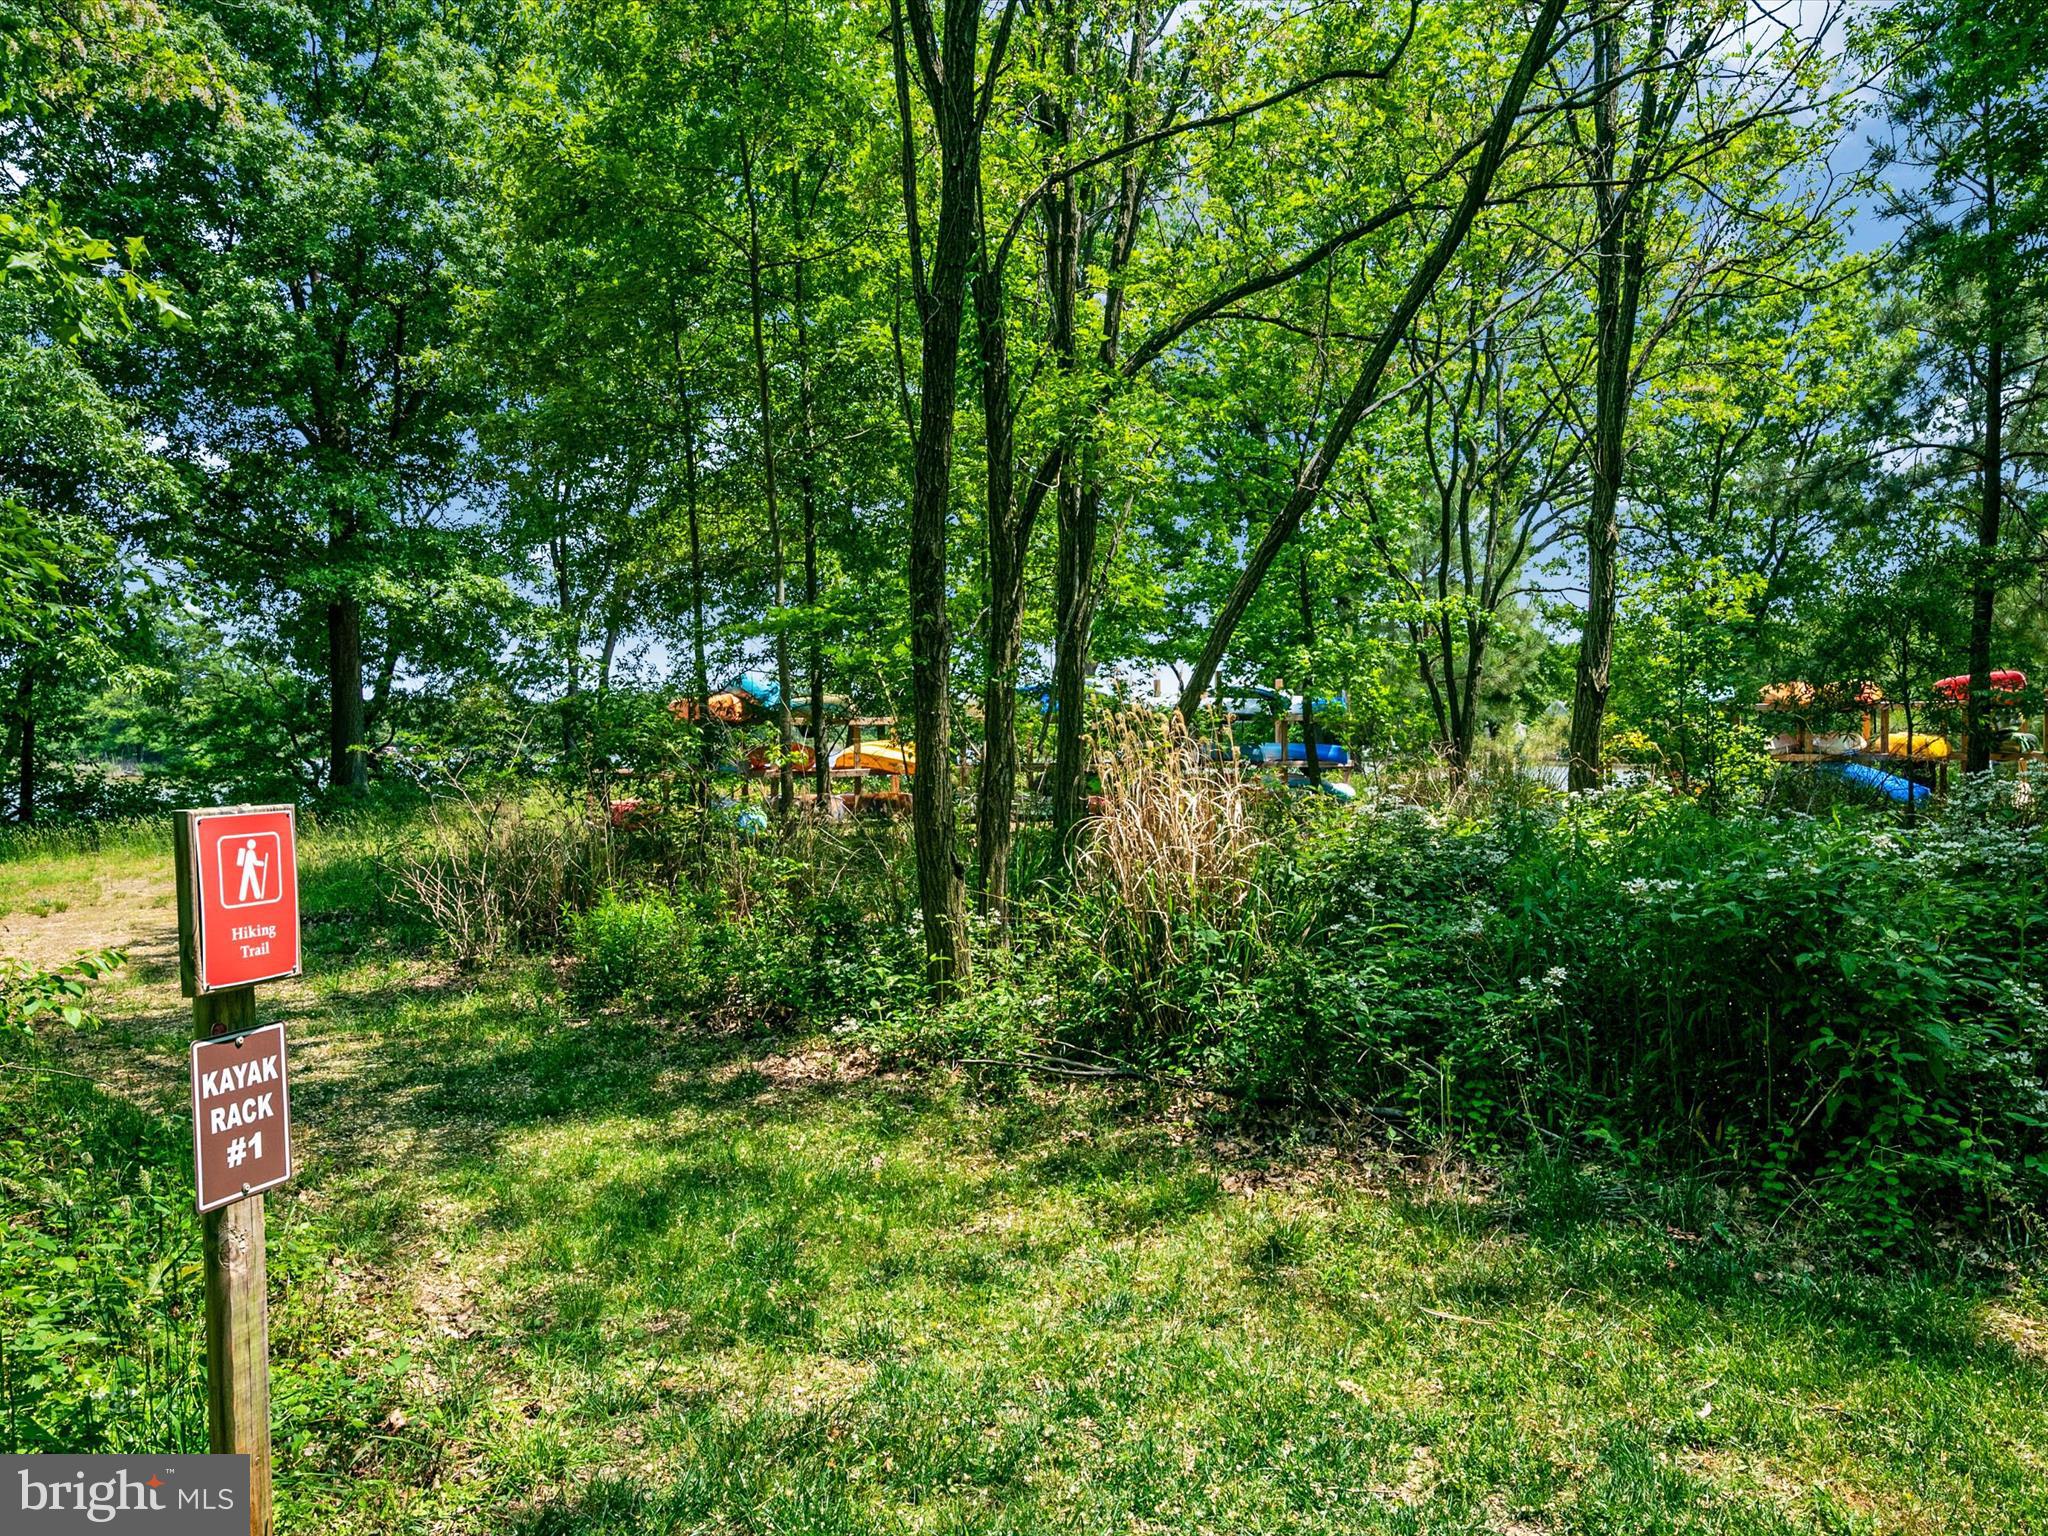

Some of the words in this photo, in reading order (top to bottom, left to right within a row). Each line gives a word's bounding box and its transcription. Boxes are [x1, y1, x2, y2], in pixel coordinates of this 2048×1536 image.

[231, 924, 277, 941] Hiking
[240, 942, 270, 959] Trail
[202, 1054, 279, 1100] KAYAK
[210, 1092, 274, 1135] RACK
[226, 1131, 263, 1169] #1
